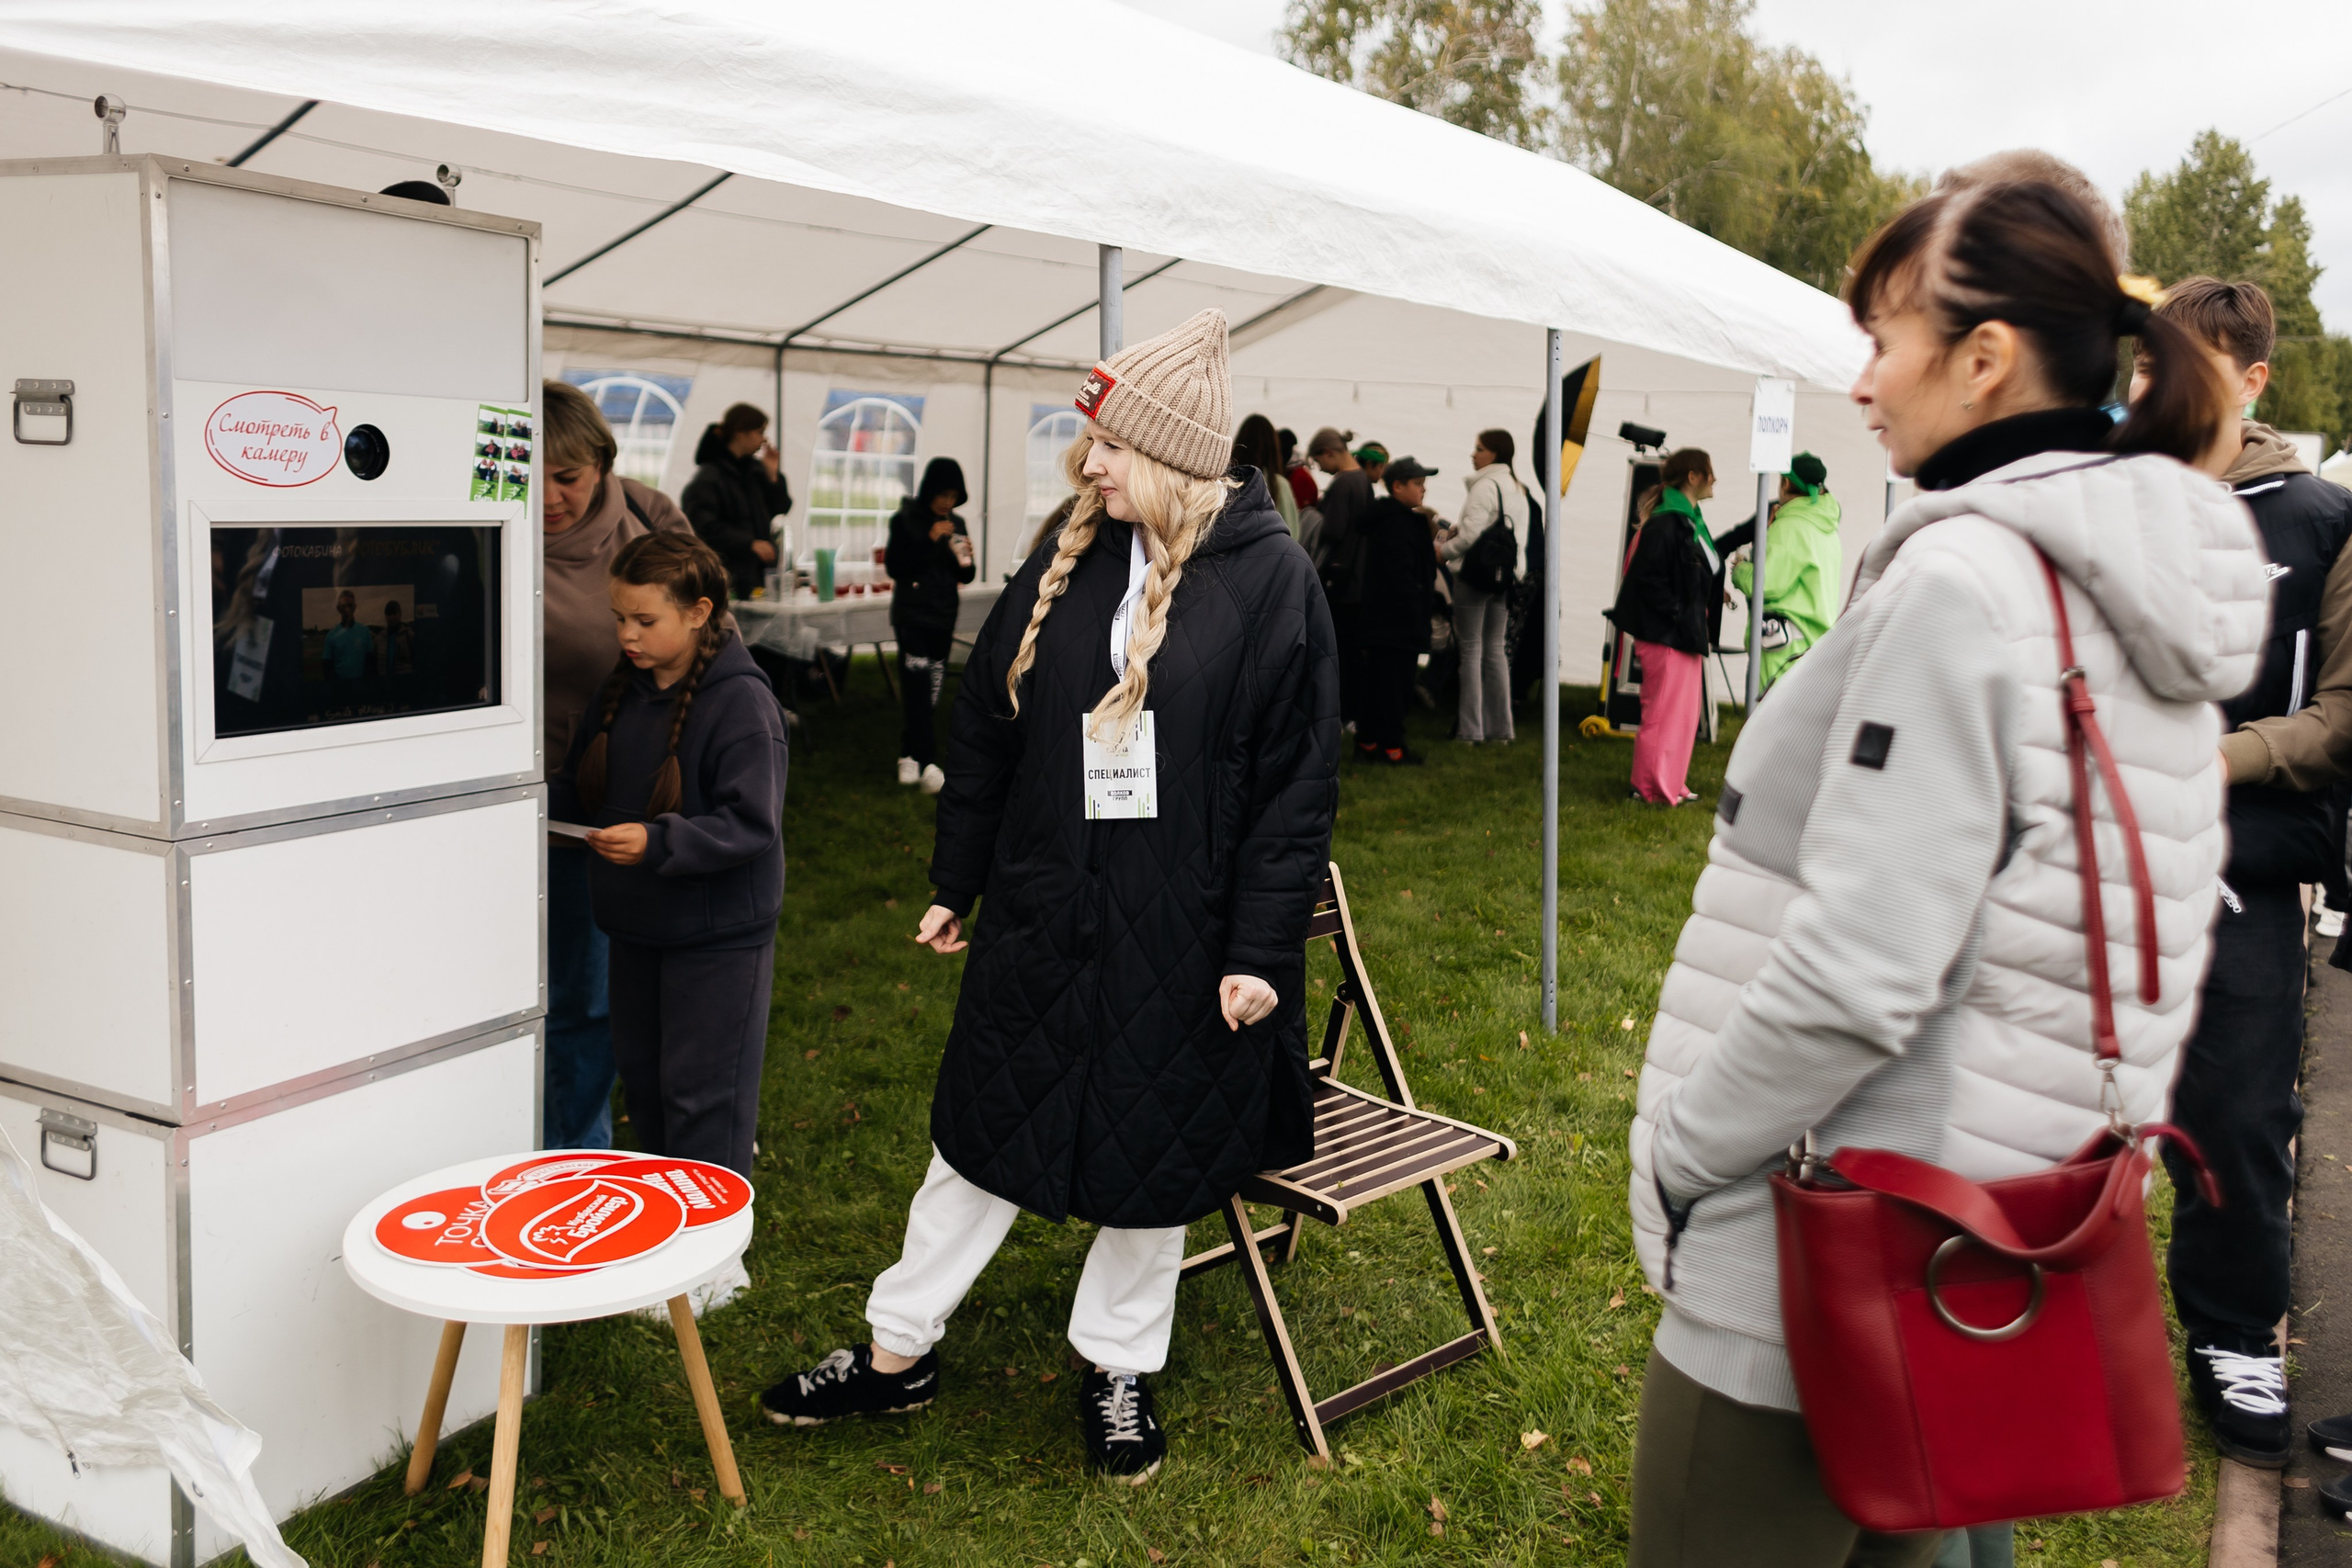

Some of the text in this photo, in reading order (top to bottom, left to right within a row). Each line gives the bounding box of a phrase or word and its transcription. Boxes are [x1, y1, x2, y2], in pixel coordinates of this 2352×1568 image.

[219, 412, 331, 446] Смотреть в
[1757, 415, 1789, 434] ПОПКОРН
[241, 445, 309, 474] камеру
[1088, 767, 1151, 781] СПЕЦИАЛИСТ
[566, 1193, 610, 1226] Кузбасский
[566, 1195, 629, 1238] Бройлер
